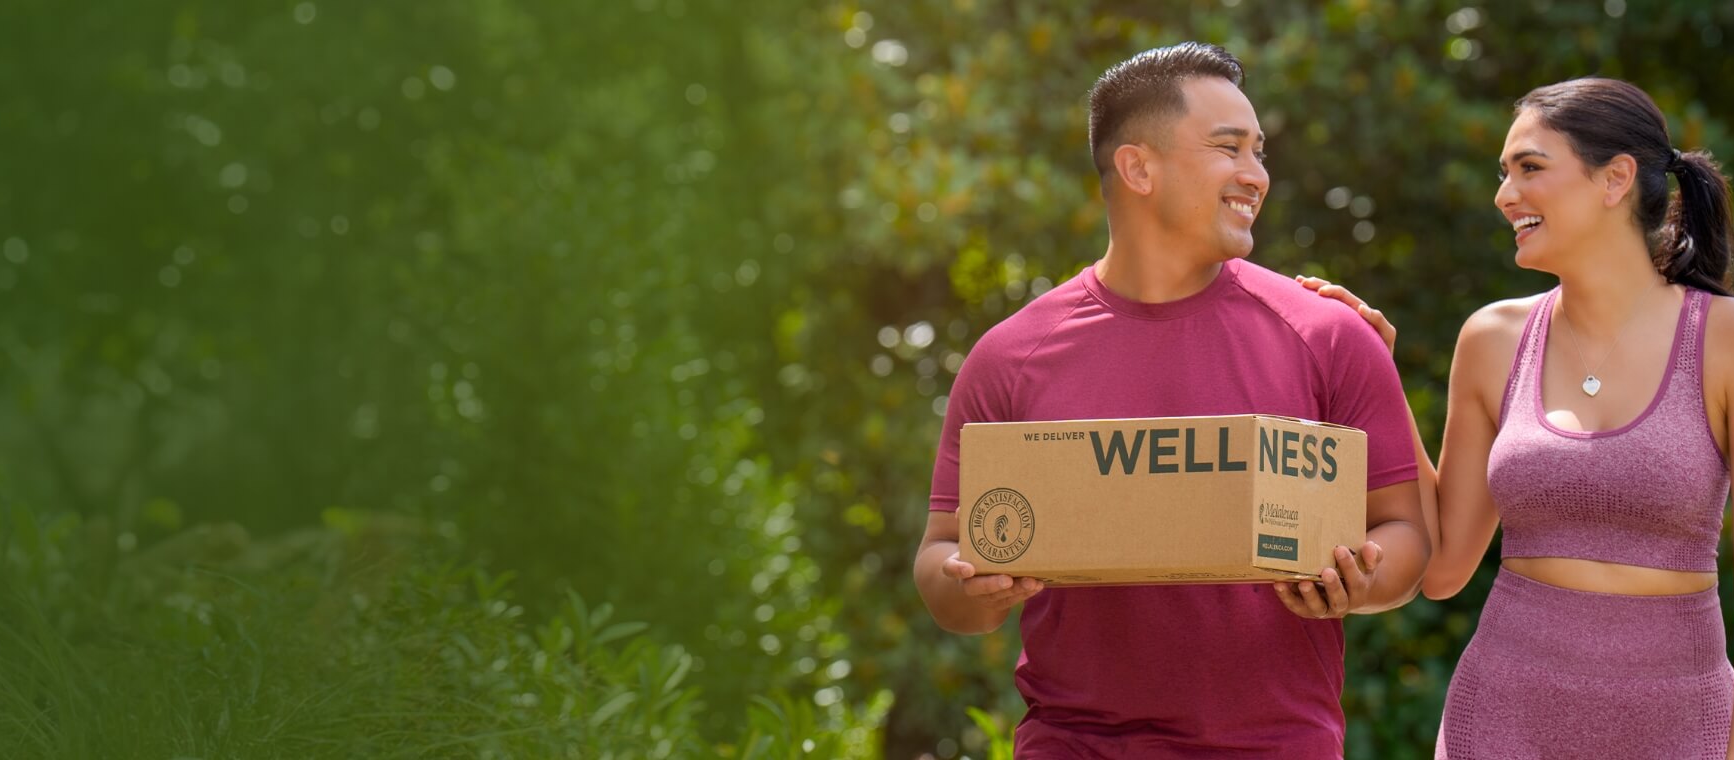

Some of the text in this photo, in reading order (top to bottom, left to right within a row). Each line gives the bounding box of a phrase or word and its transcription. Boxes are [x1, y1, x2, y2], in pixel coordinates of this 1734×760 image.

[1024, 432, 1040, 441] WE
[1043, 431, 1085, 441] DELIVER
[974, 493, 1031, 529] 100% SATISFACTION
[1265, 502, 1299, 521] Melaleuca
[978, 537, 1026, 558] GUARANTEE
